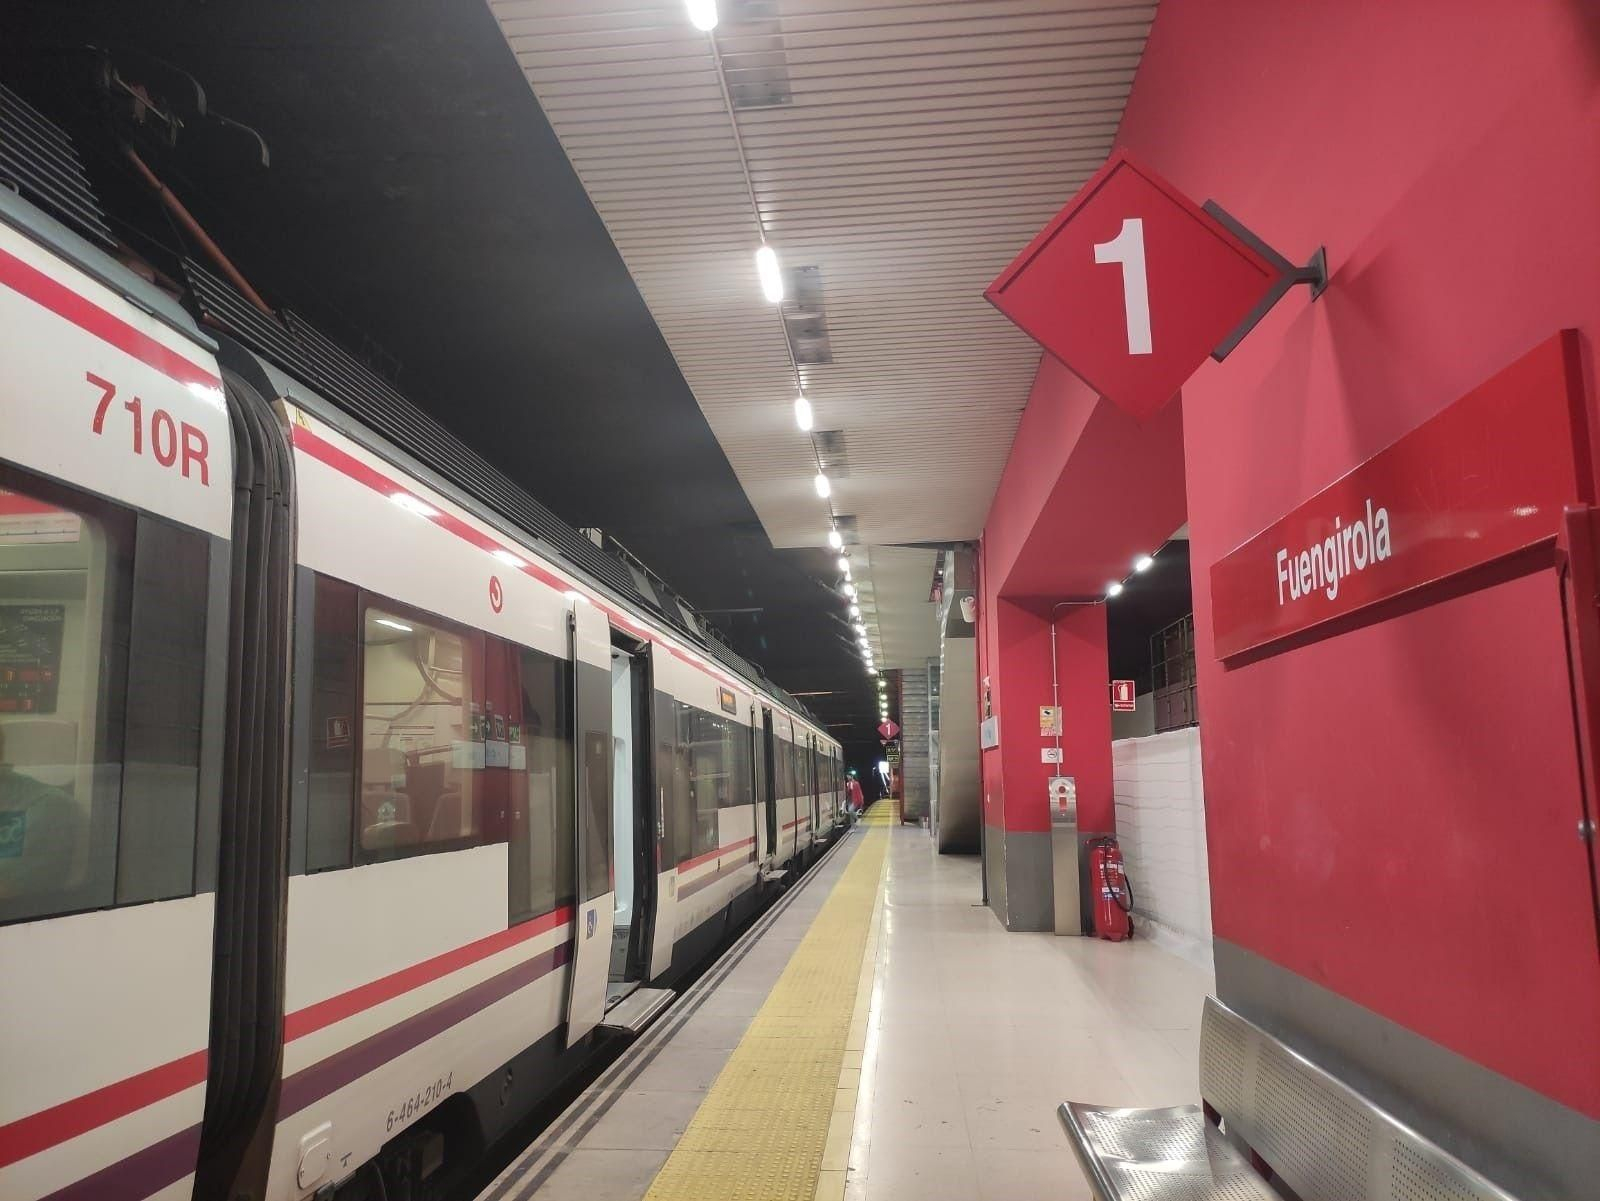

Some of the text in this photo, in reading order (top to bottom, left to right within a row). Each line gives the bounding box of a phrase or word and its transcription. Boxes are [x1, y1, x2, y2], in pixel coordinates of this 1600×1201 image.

[1094, 218, 1152, 355] 1
[86, 371, 210, 487] 710R
[1276, 498, 1392, 605] Fuengirola
[885, 723, 891, 735] 1
[386, 1072, 454, 1132] 6-464-210-4
